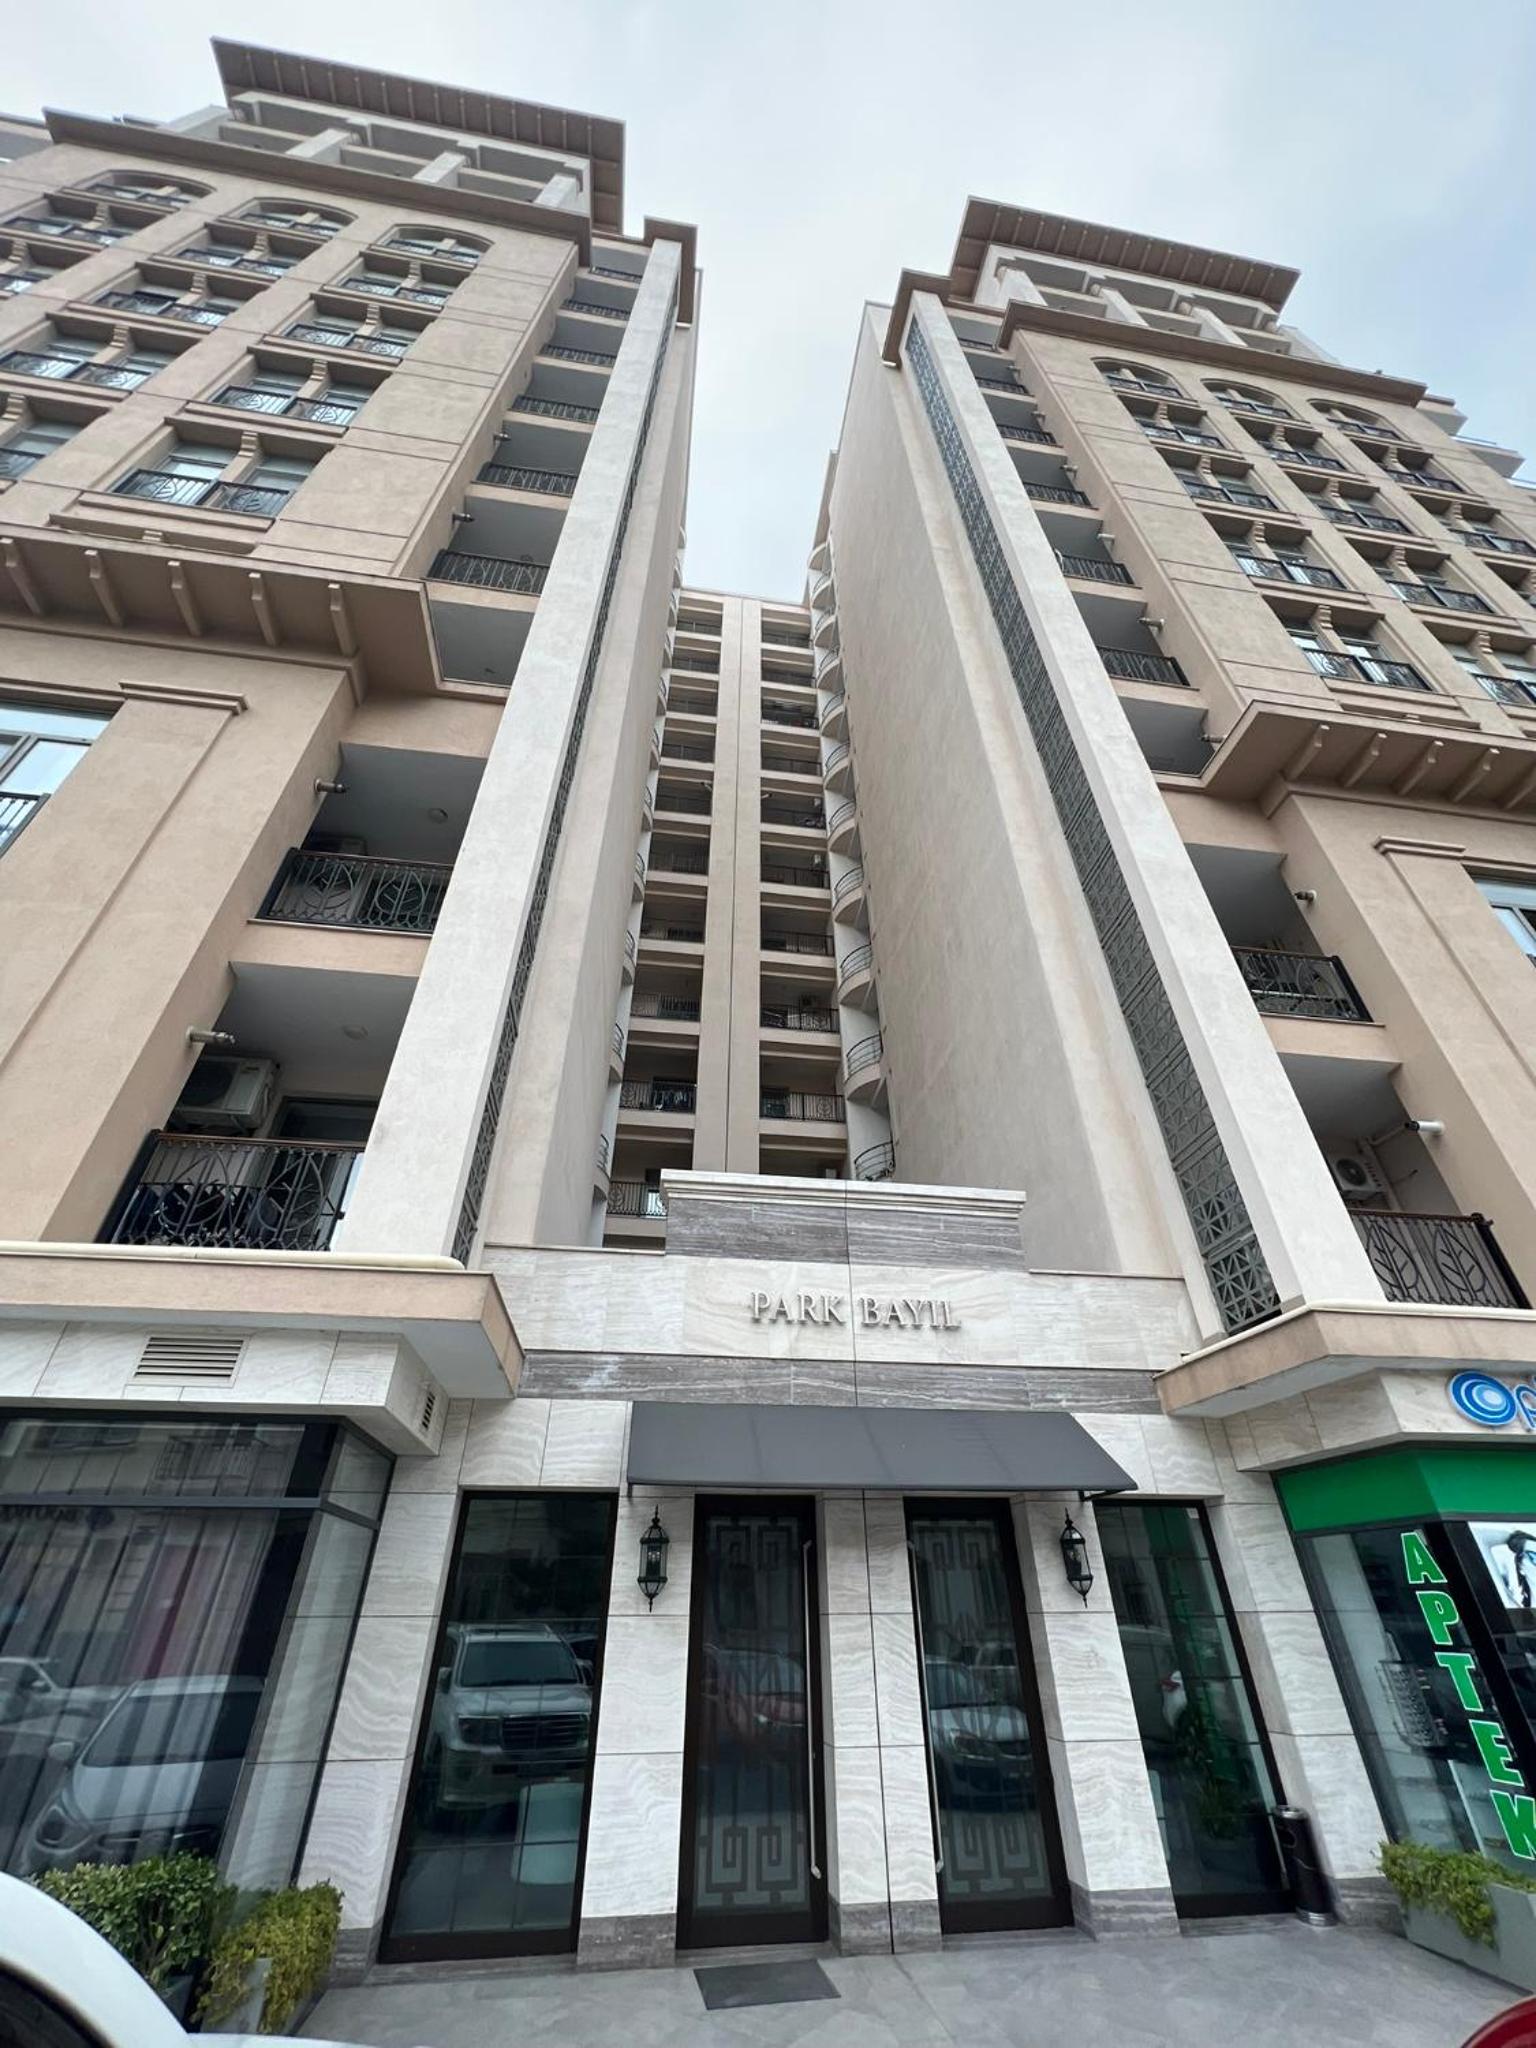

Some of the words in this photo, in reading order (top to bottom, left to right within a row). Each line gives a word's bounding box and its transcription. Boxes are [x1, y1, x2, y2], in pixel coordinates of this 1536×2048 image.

[751, 1290, 847, 1325] PARK
[860, 1296, 962, 1330] BAYIL
[1400, 1531, 1536, 1860] APTEK
